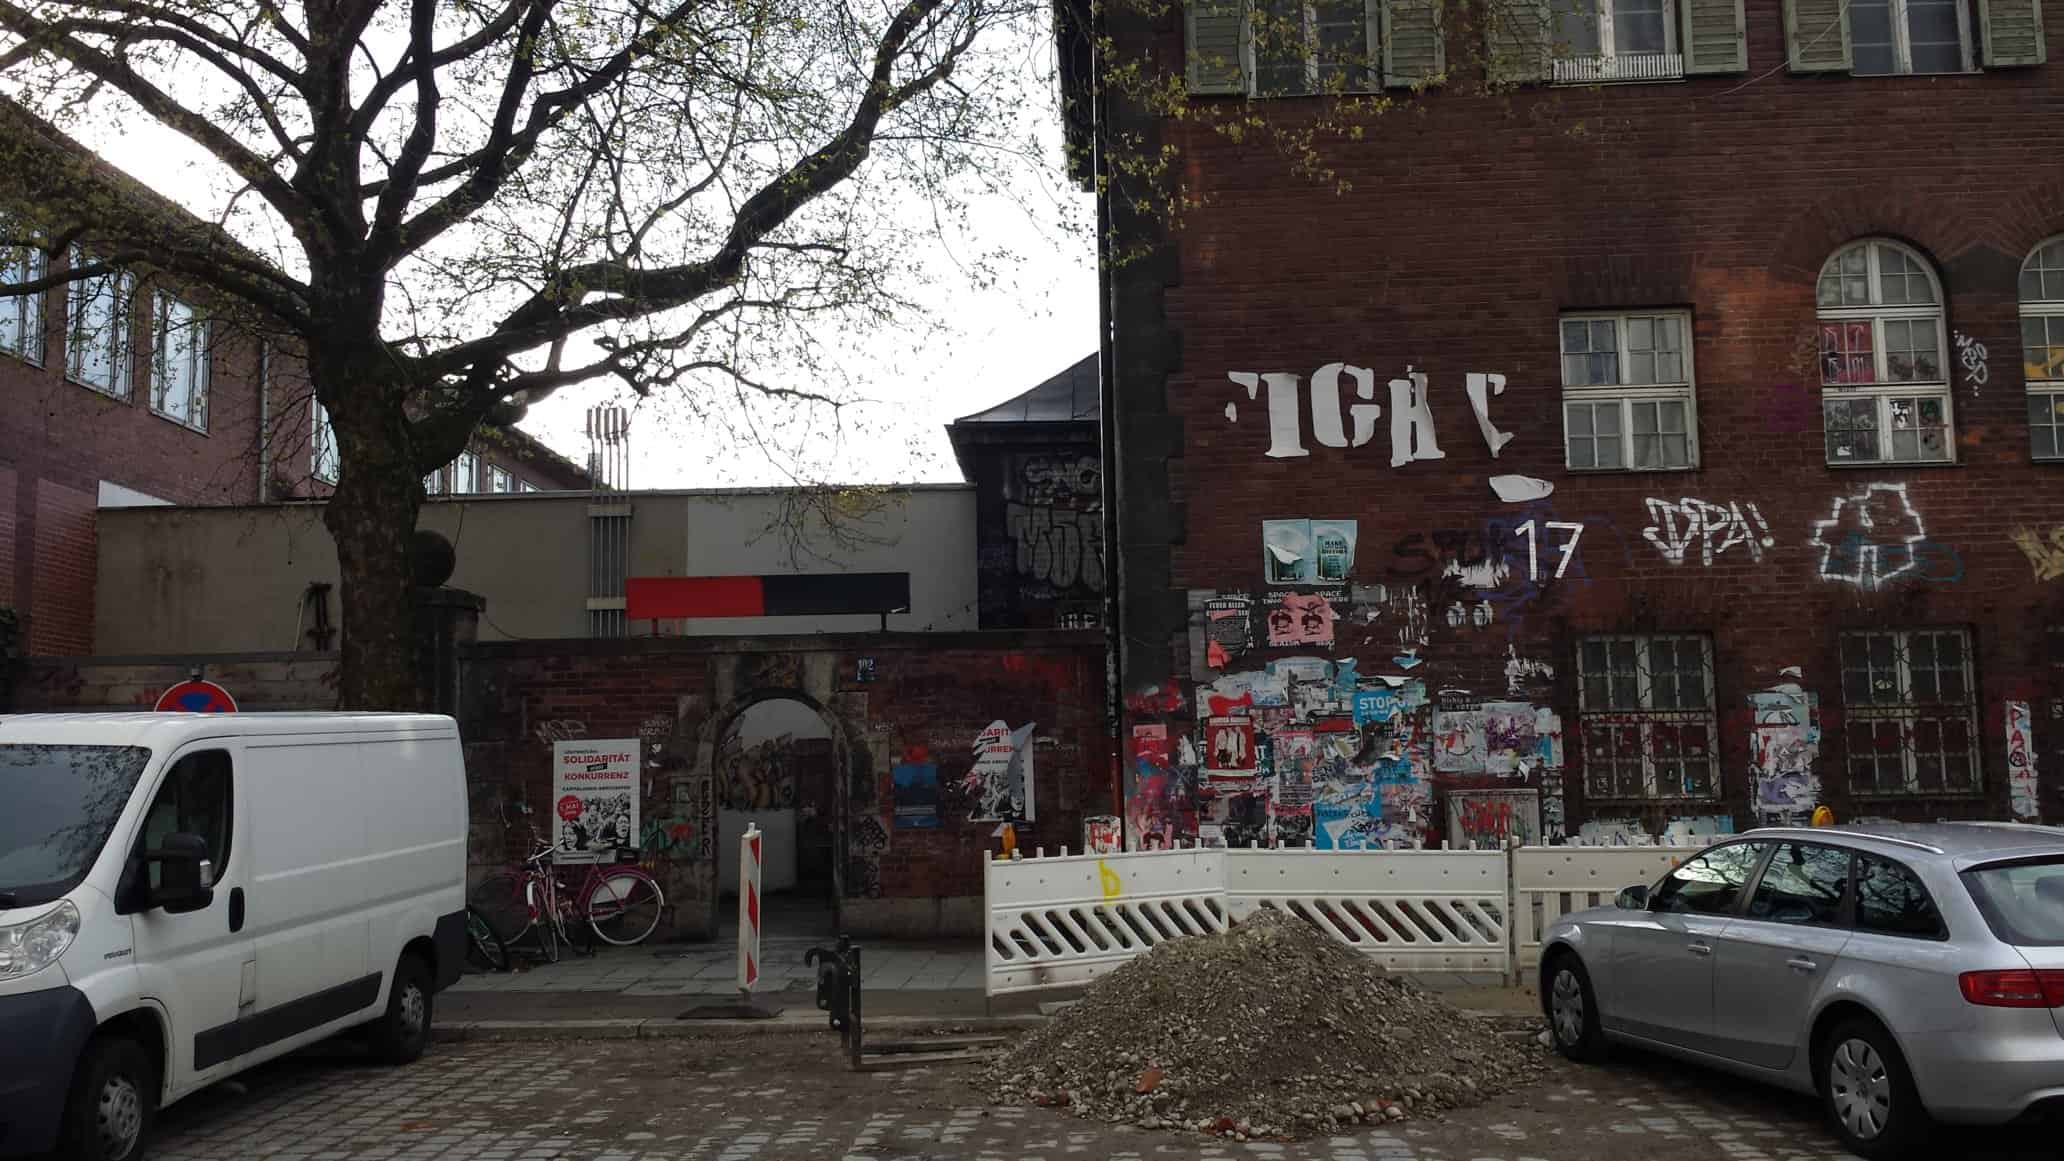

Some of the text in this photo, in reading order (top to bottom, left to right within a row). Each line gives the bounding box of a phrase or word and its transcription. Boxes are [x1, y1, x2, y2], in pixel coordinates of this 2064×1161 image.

[1514, 519, 1585, 582] 17
[1359, 695, 1393, 710] STOP
[563, 753, 631, 764] SOLIDARITÄT
[564, 771, 629, 780] KONKURRENZ
